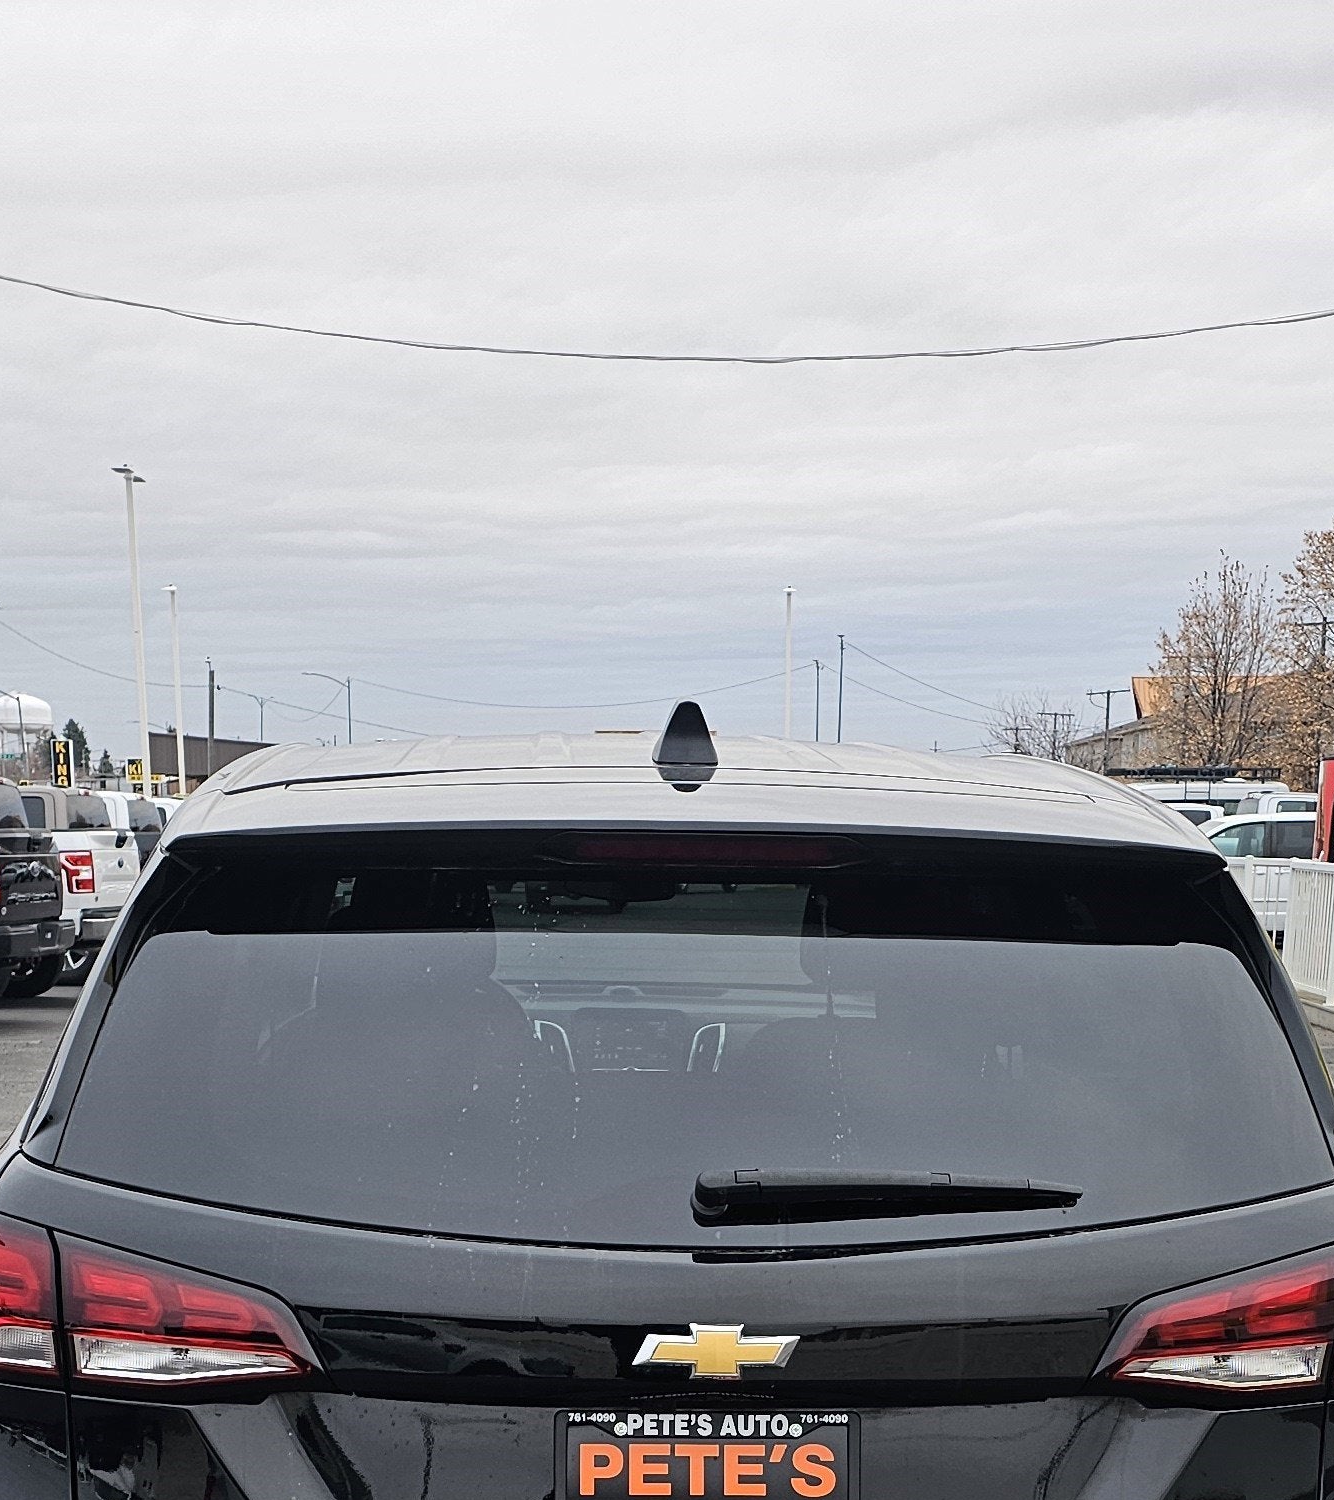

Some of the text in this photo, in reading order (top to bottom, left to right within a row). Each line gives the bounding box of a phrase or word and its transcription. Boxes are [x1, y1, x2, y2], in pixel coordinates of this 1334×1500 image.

[55, 741, 69, 788] KING
[567, 1412, 616, 1423] 761-4090
[627, 1413, 789, 1437] PETE'S AUTO
[799, 1413, 849, 1425] 761-4090
[579, 1443, 837, 1498] PETE'S
